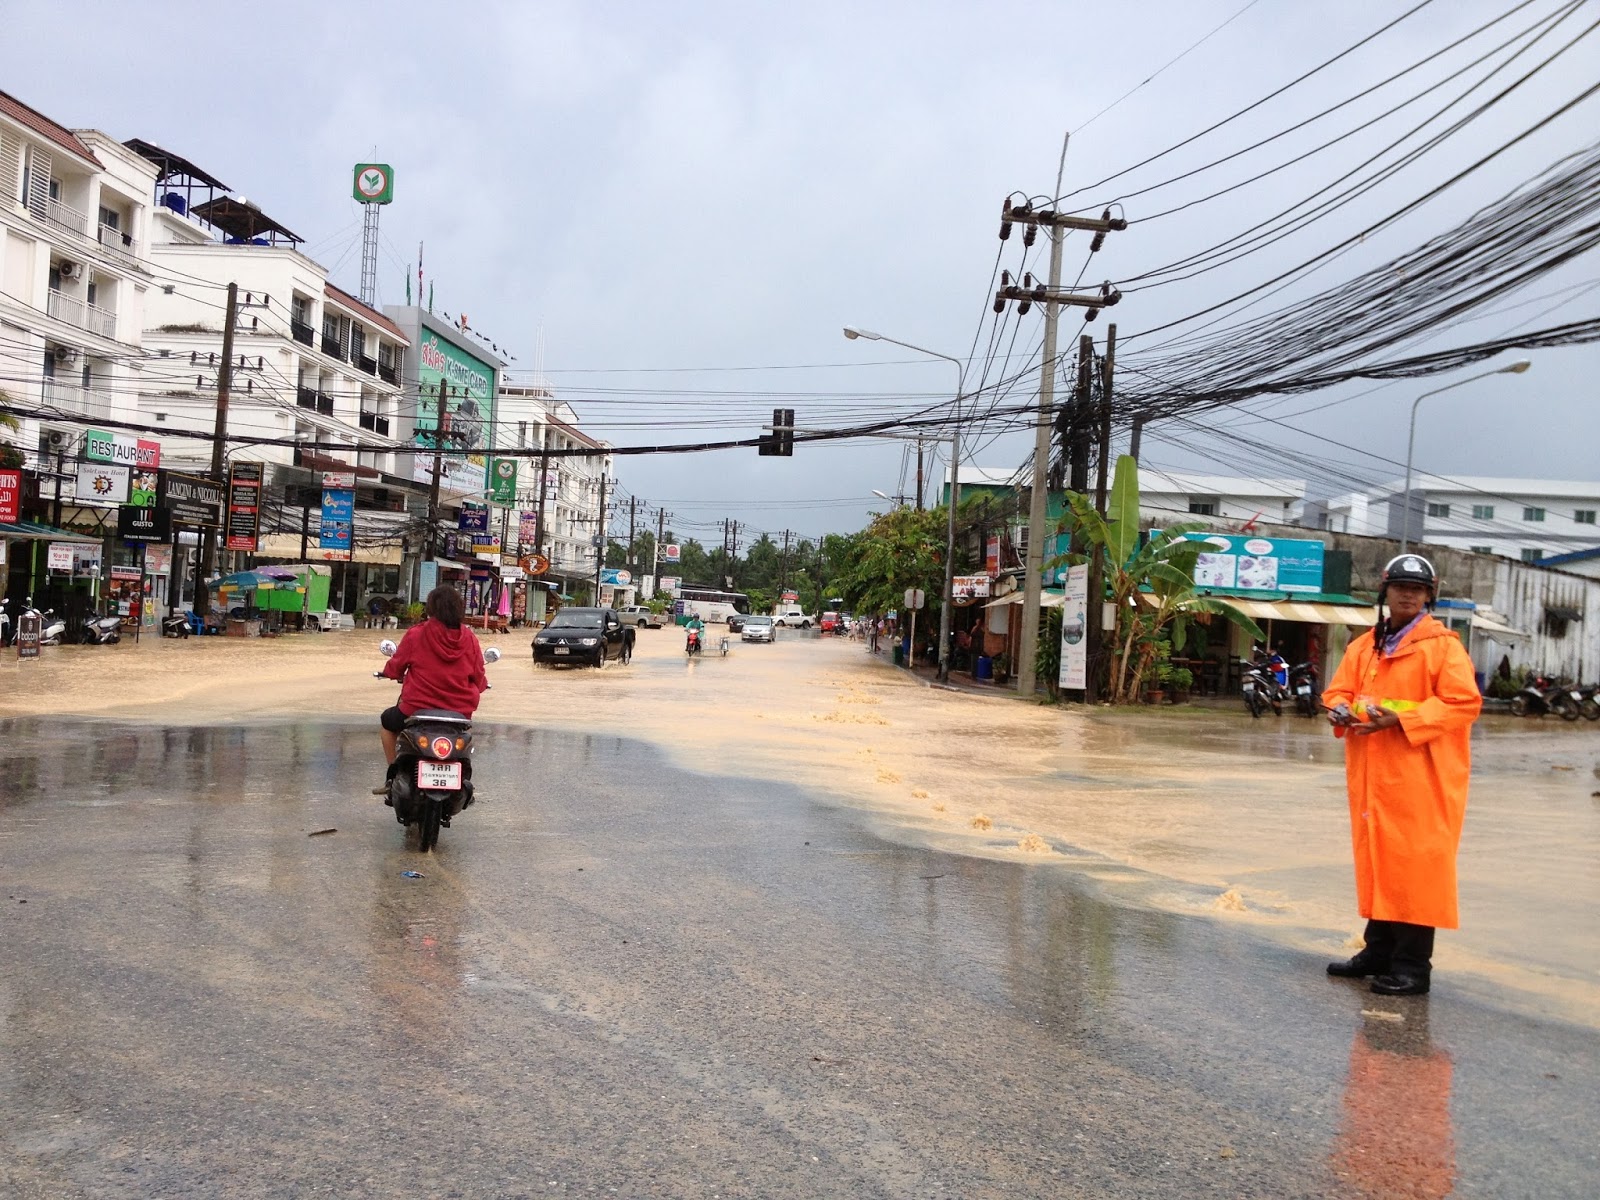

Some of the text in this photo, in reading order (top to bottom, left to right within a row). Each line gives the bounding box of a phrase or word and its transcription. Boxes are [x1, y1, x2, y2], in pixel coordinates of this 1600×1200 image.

[447, 358, 487, 396] K-SME CARD
[91, 440, 155, 464] RESTAURANT
[0, 475, 17, 488] HTS
[168, 481, 192, 498] LANCINI
[197, 488, 220, 502] NICCOLI
[432, 779, 447, 787] 36
